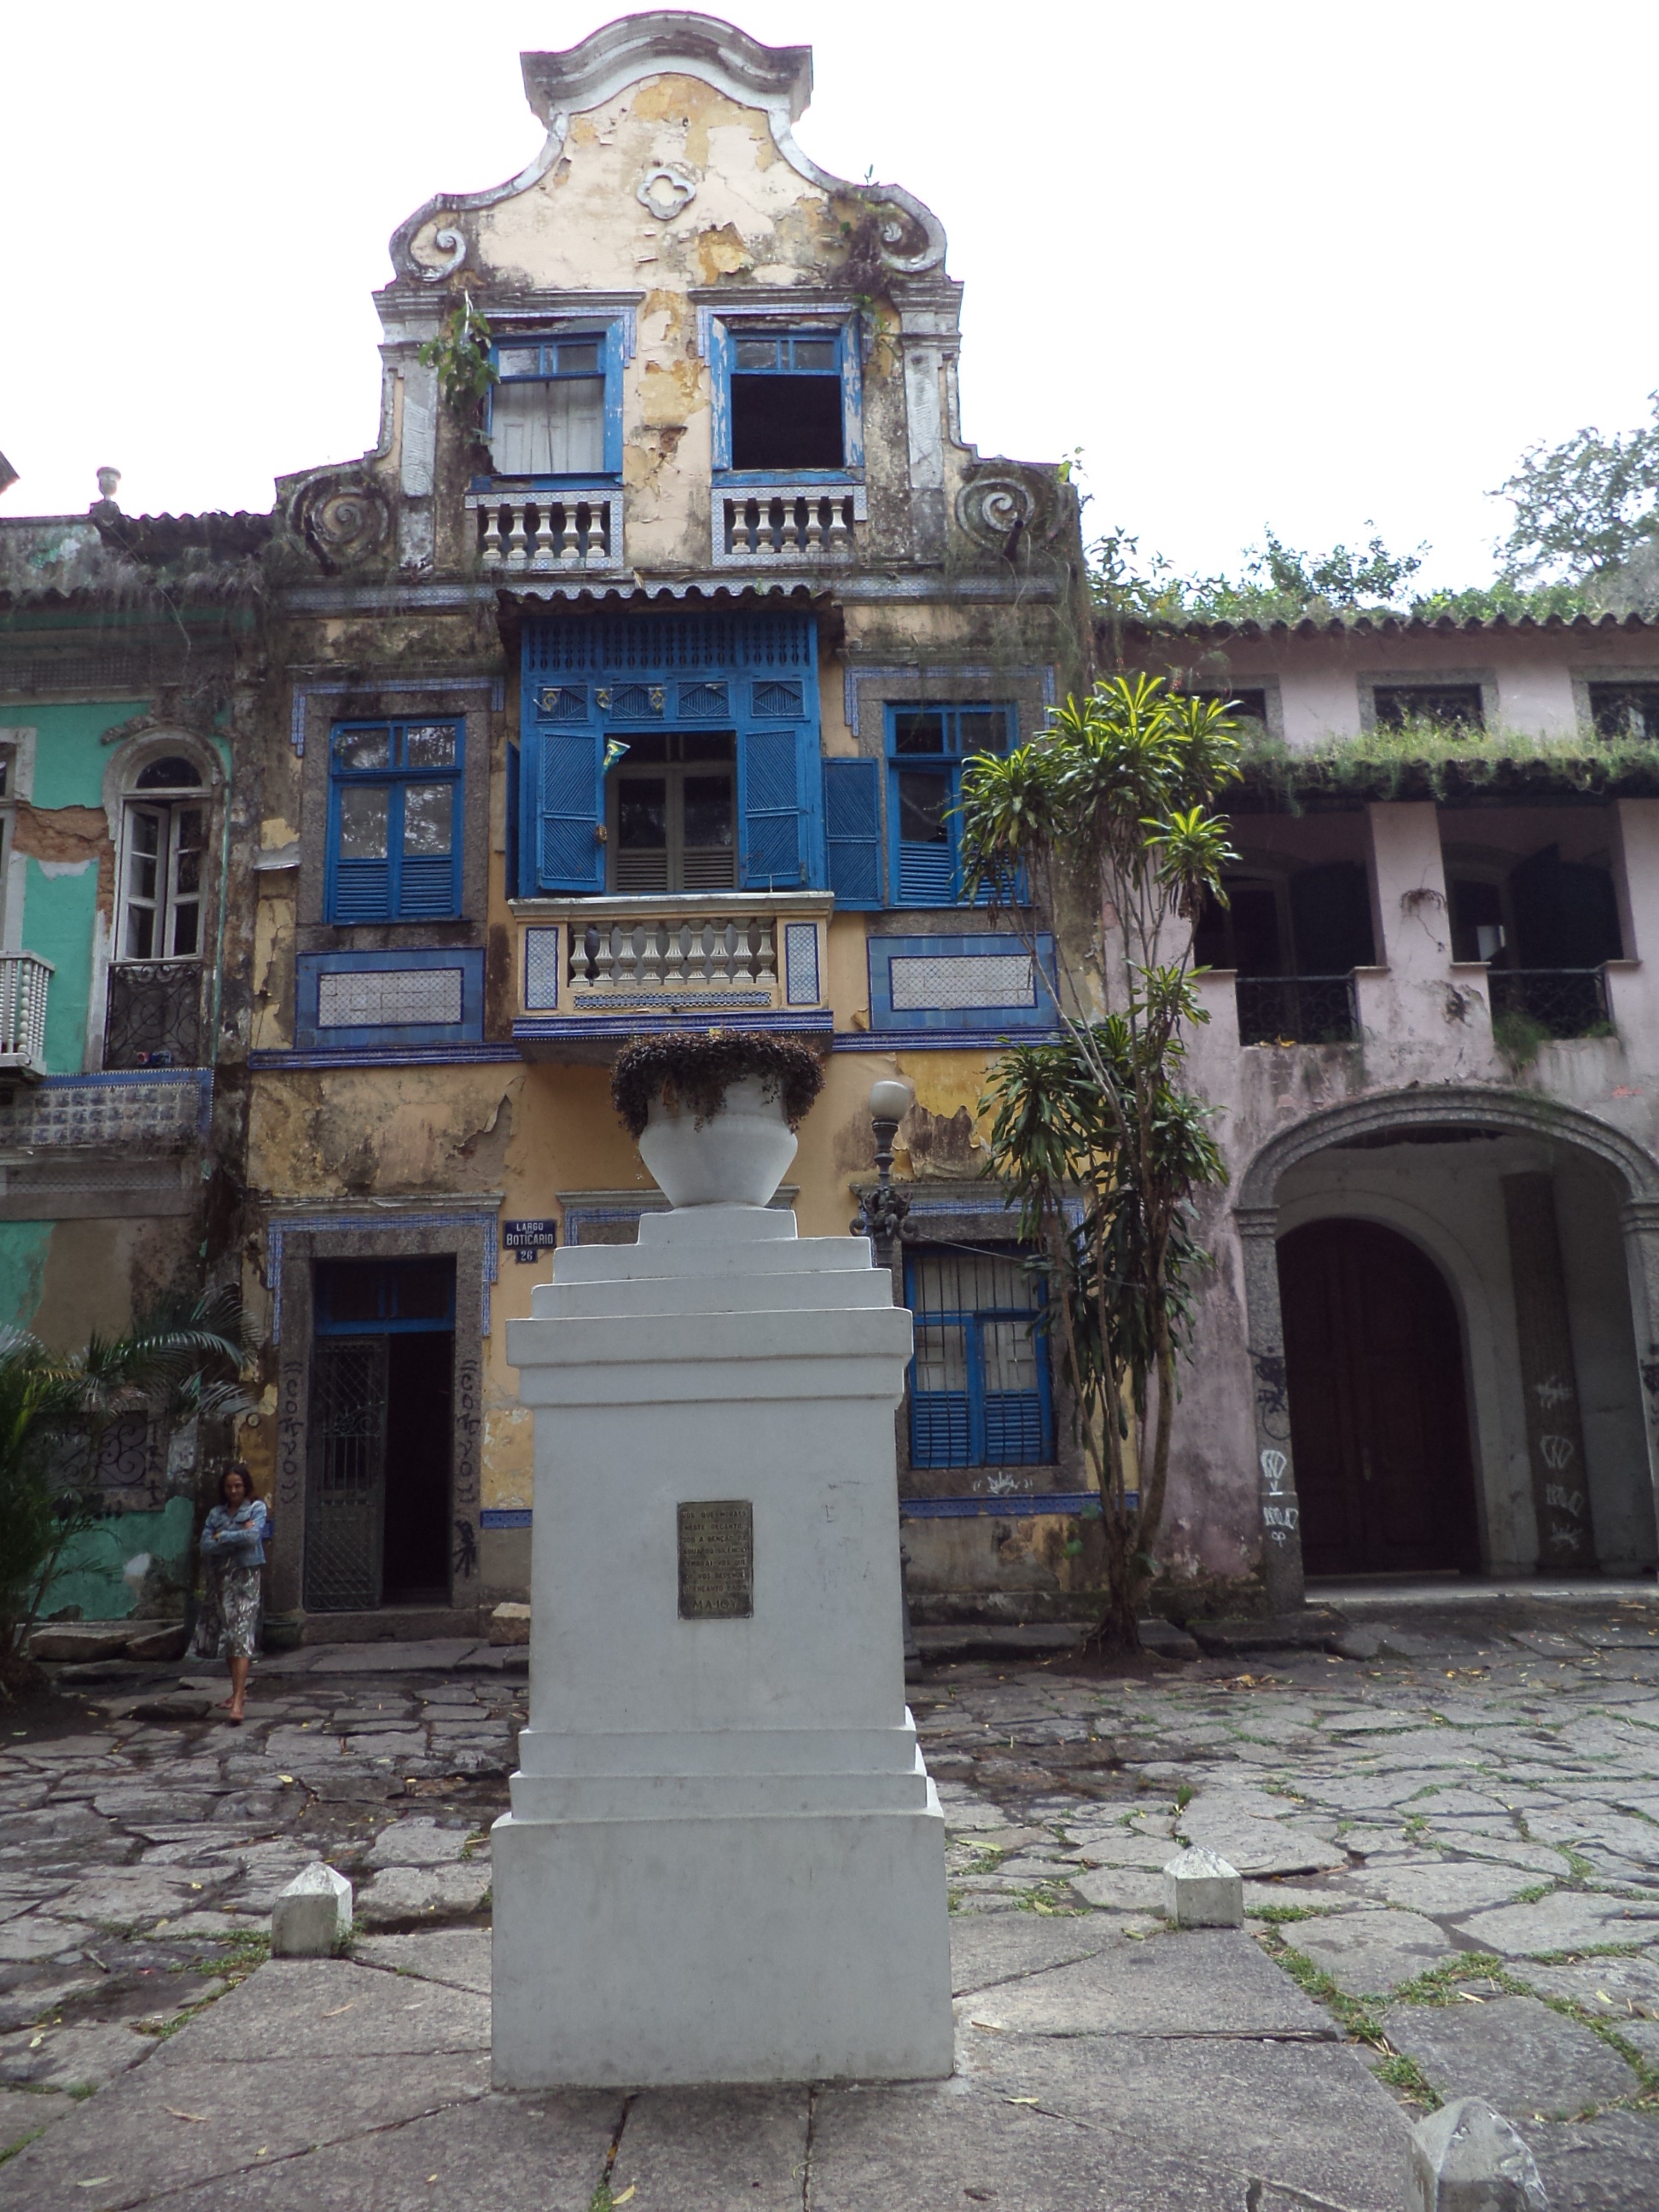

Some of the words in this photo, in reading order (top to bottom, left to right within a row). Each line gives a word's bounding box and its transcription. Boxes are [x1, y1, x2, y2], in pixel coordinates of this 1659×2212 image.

[516, 1222, 544, 1231] LARGO
[506, 1233, 553, 1245] BOTICARIO
[521, 1250, 533, 1260] 26
